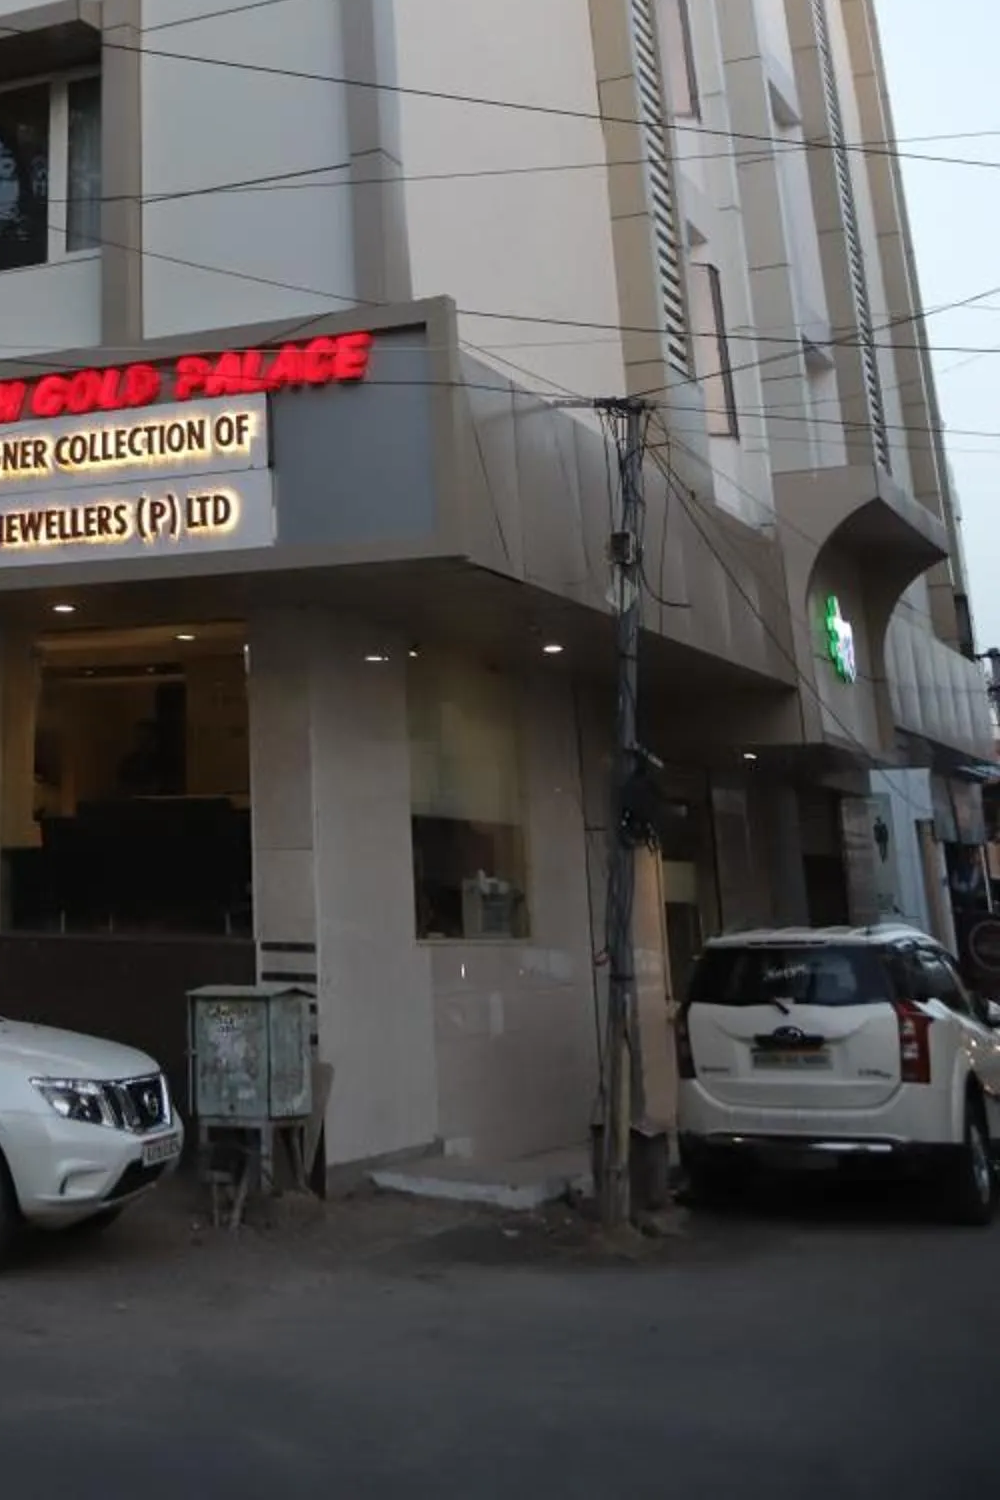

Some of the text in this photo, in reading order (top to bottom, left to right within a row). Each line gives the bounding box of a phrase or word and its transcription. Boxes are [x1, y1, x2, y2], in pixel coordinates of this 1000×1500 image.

[31, 365, 160, 416] GOLD
[174, 332, 372, 400] PALACE
[54, 418, 206, 466] COLLECTION
[214, 413, 250, 446] OF
[137, 493, 178, 536] (P)
[186, 494, 232, 528] LTD
